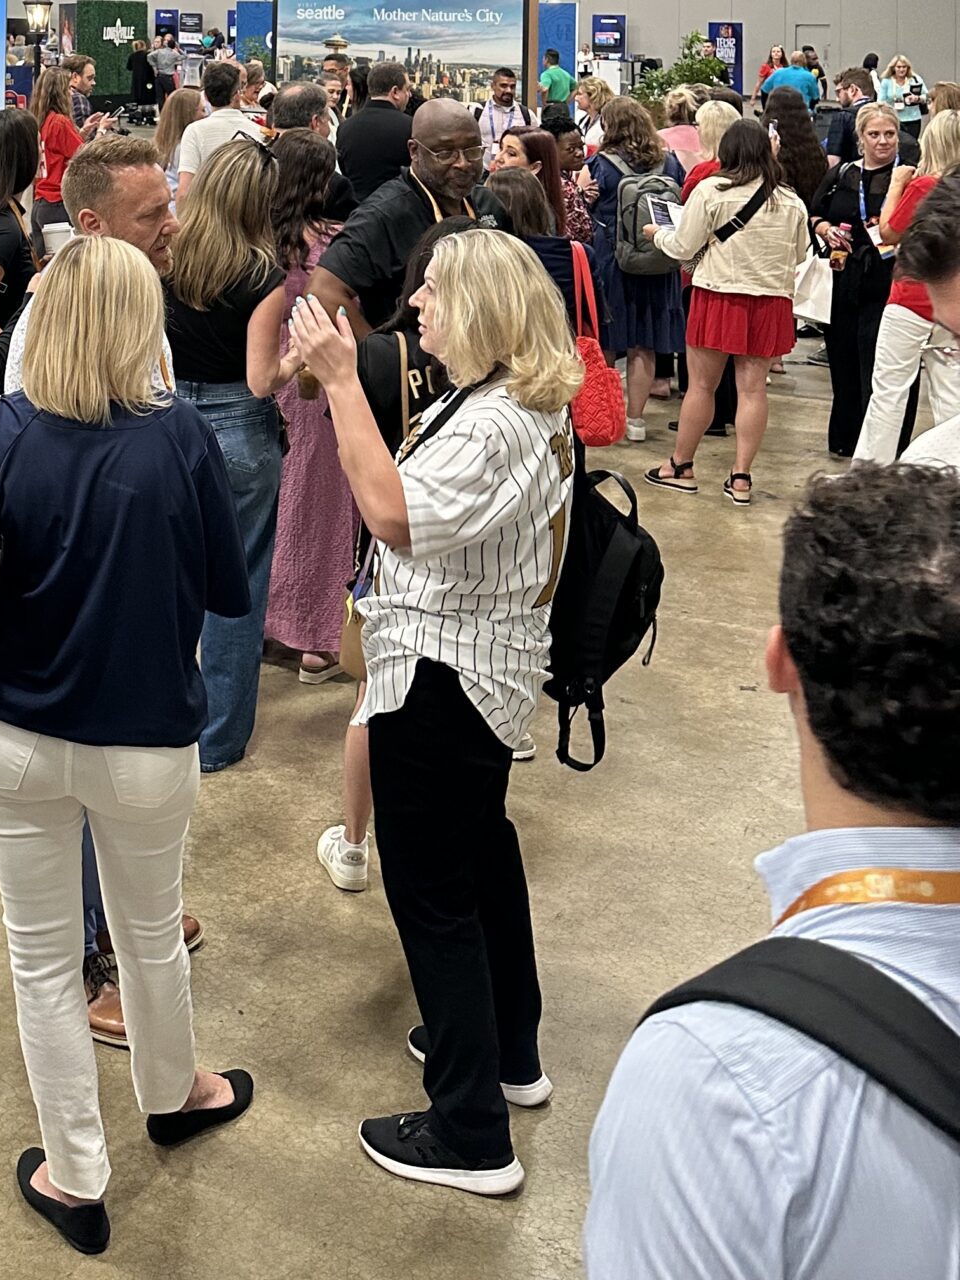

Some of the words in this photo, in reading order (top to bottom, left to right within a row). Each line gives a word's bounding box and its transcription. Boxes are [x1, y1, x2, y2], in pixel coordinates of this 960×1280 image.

[296, 4, 345, 20] seattle
[373, 8, 417, 21] Mother
[421, 8, 472, 22] Nature's
[475, 8, 503, 24] City
